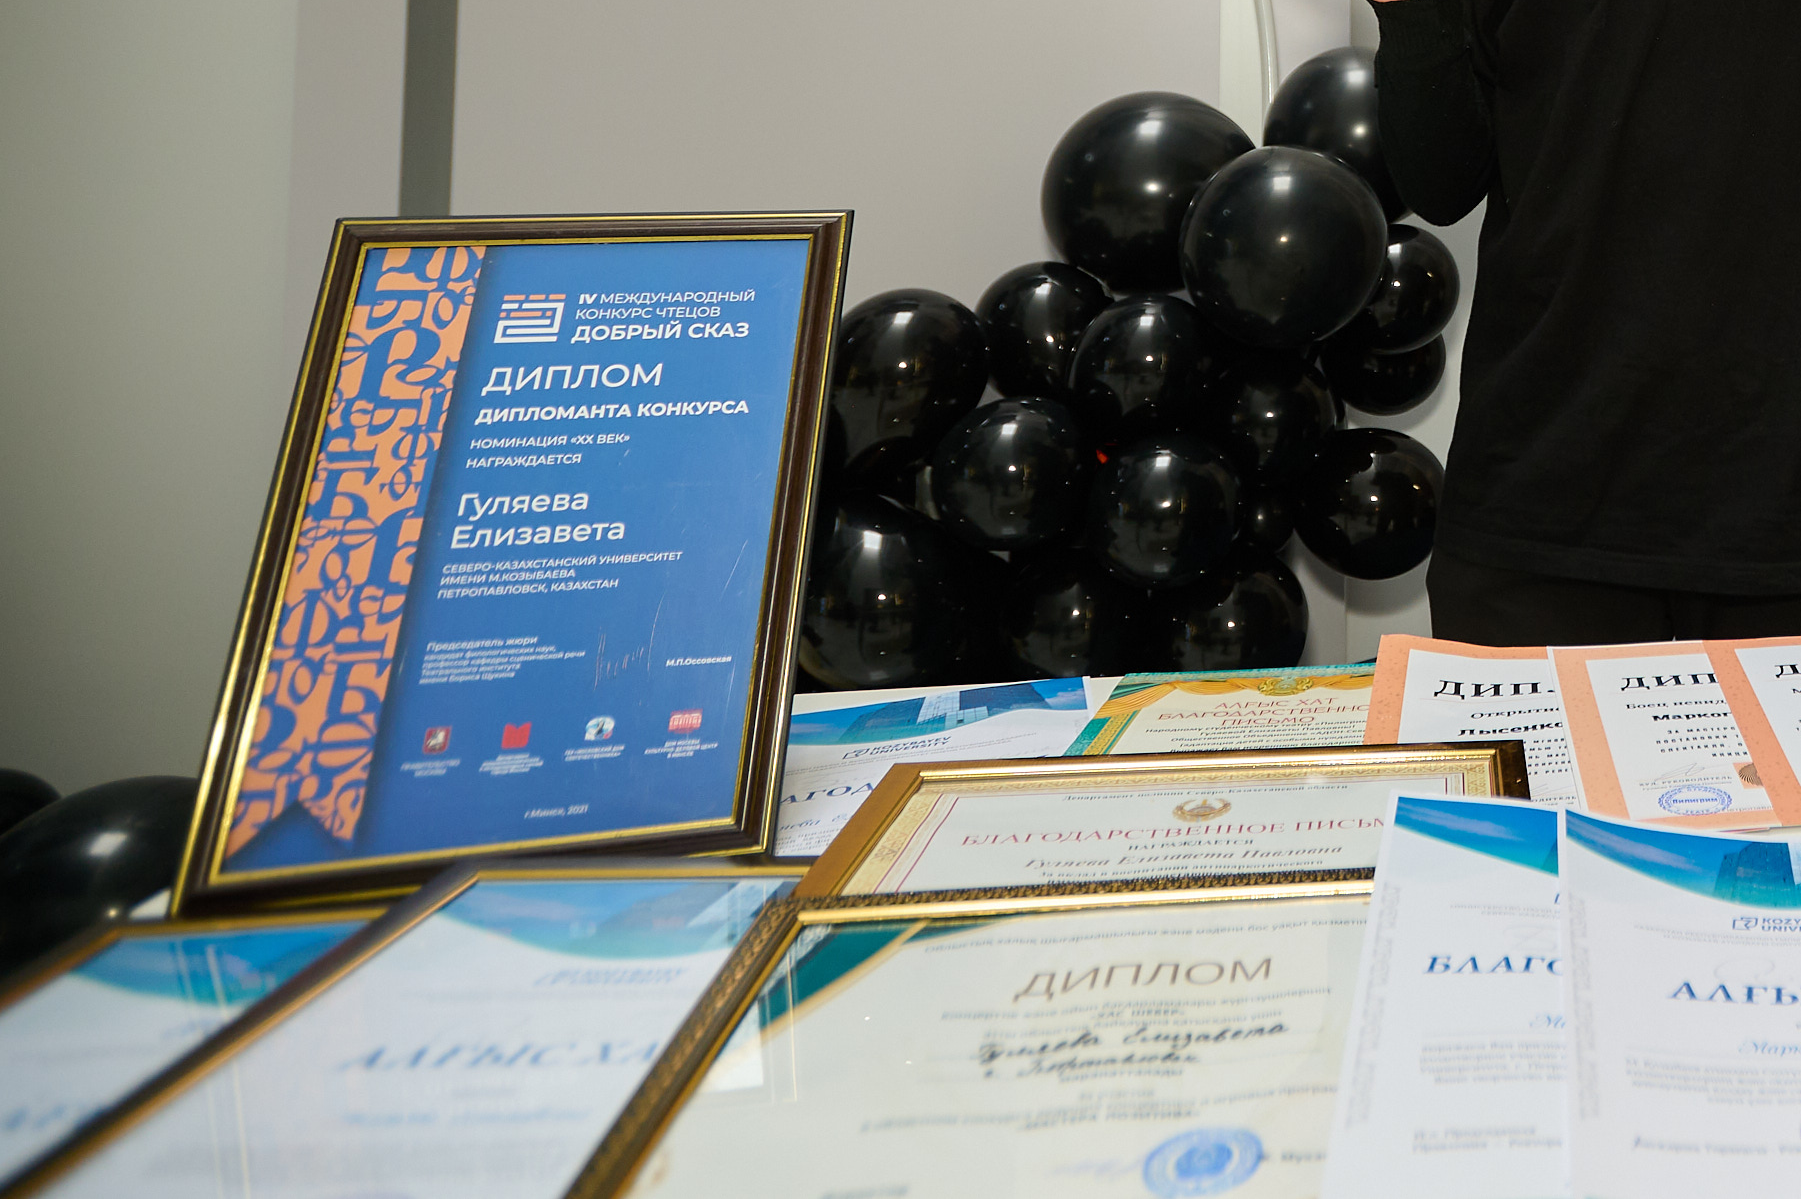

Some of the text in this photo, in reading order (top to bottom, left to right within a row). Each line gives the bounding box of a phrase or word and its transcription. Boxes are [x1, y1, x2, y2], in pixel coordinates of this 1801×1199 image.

[578, 289, 756, 305] IV МЕЖДУНАРОДНЫЙ
[575, 306, 721, 320] КОНКУРС ЧТЕЦОВ
[570, 320, 750, 344] ДОБРЫЙ СКАЗ
[480, 362, 664, 396] ДИПЛОМ
[474, 401, 749, 425] ДИПЛОМАНТА КОНКУРСА
[470, 435, 567, 449] НОМИНАЦИЯ
[597, 433, 630, 444] ВЕК»
[465, 454, 582, 469] НАГРАЖДАЕТСЯ
[457, 492, 589, 521] Гуляева
[450, 521, 625, 550] Елизавета
[442, 551, 683, 574] СЕВЕРО-КАЗАХСТАНСКИЙ УНИВЕРСИТЕТ
[440, 569, 576, 586] ИМЕНИ М.КОЗЫБАЕВА
[437, 579, 619, 599] ПЕТРОПАВЛОВСК, КАЗАХСТАН
[426, 635, 538, 652] Председатель жюри
[1434, 680, 1555, 700] ДИП
[1621, 673, 1719, 691] ДИП
[1298, 697, 1339, 706] ХАТ
[1626, 698, 1727, 711] Боец невид
[1158, 704, 1371, 721] БЛАГОДАРСТВЕННО
[1471, 707, 1559, 719] Открыти
[1652, 711, 1732, 722] Марког
[1221, 717, 1316, 726] ПИСЬМО
[870, 741, 950, 756] UNIVERSITY
[873, 736, 951, 751] KOZYBAYEV
[961, 818, 1384, 847] БЛАГОДАРСТВЕННОЕ ПИСЬМ
[1128, 838, 1254, 851] НАГРАЖДАЕТСЯ
[1025, 845, 1343, 870] Гуляева Елизавета Павловна
[1424, 955, 1563, 976] БЛАГО
[1012, 957, 1272, 1002] ДИПЛОМ
